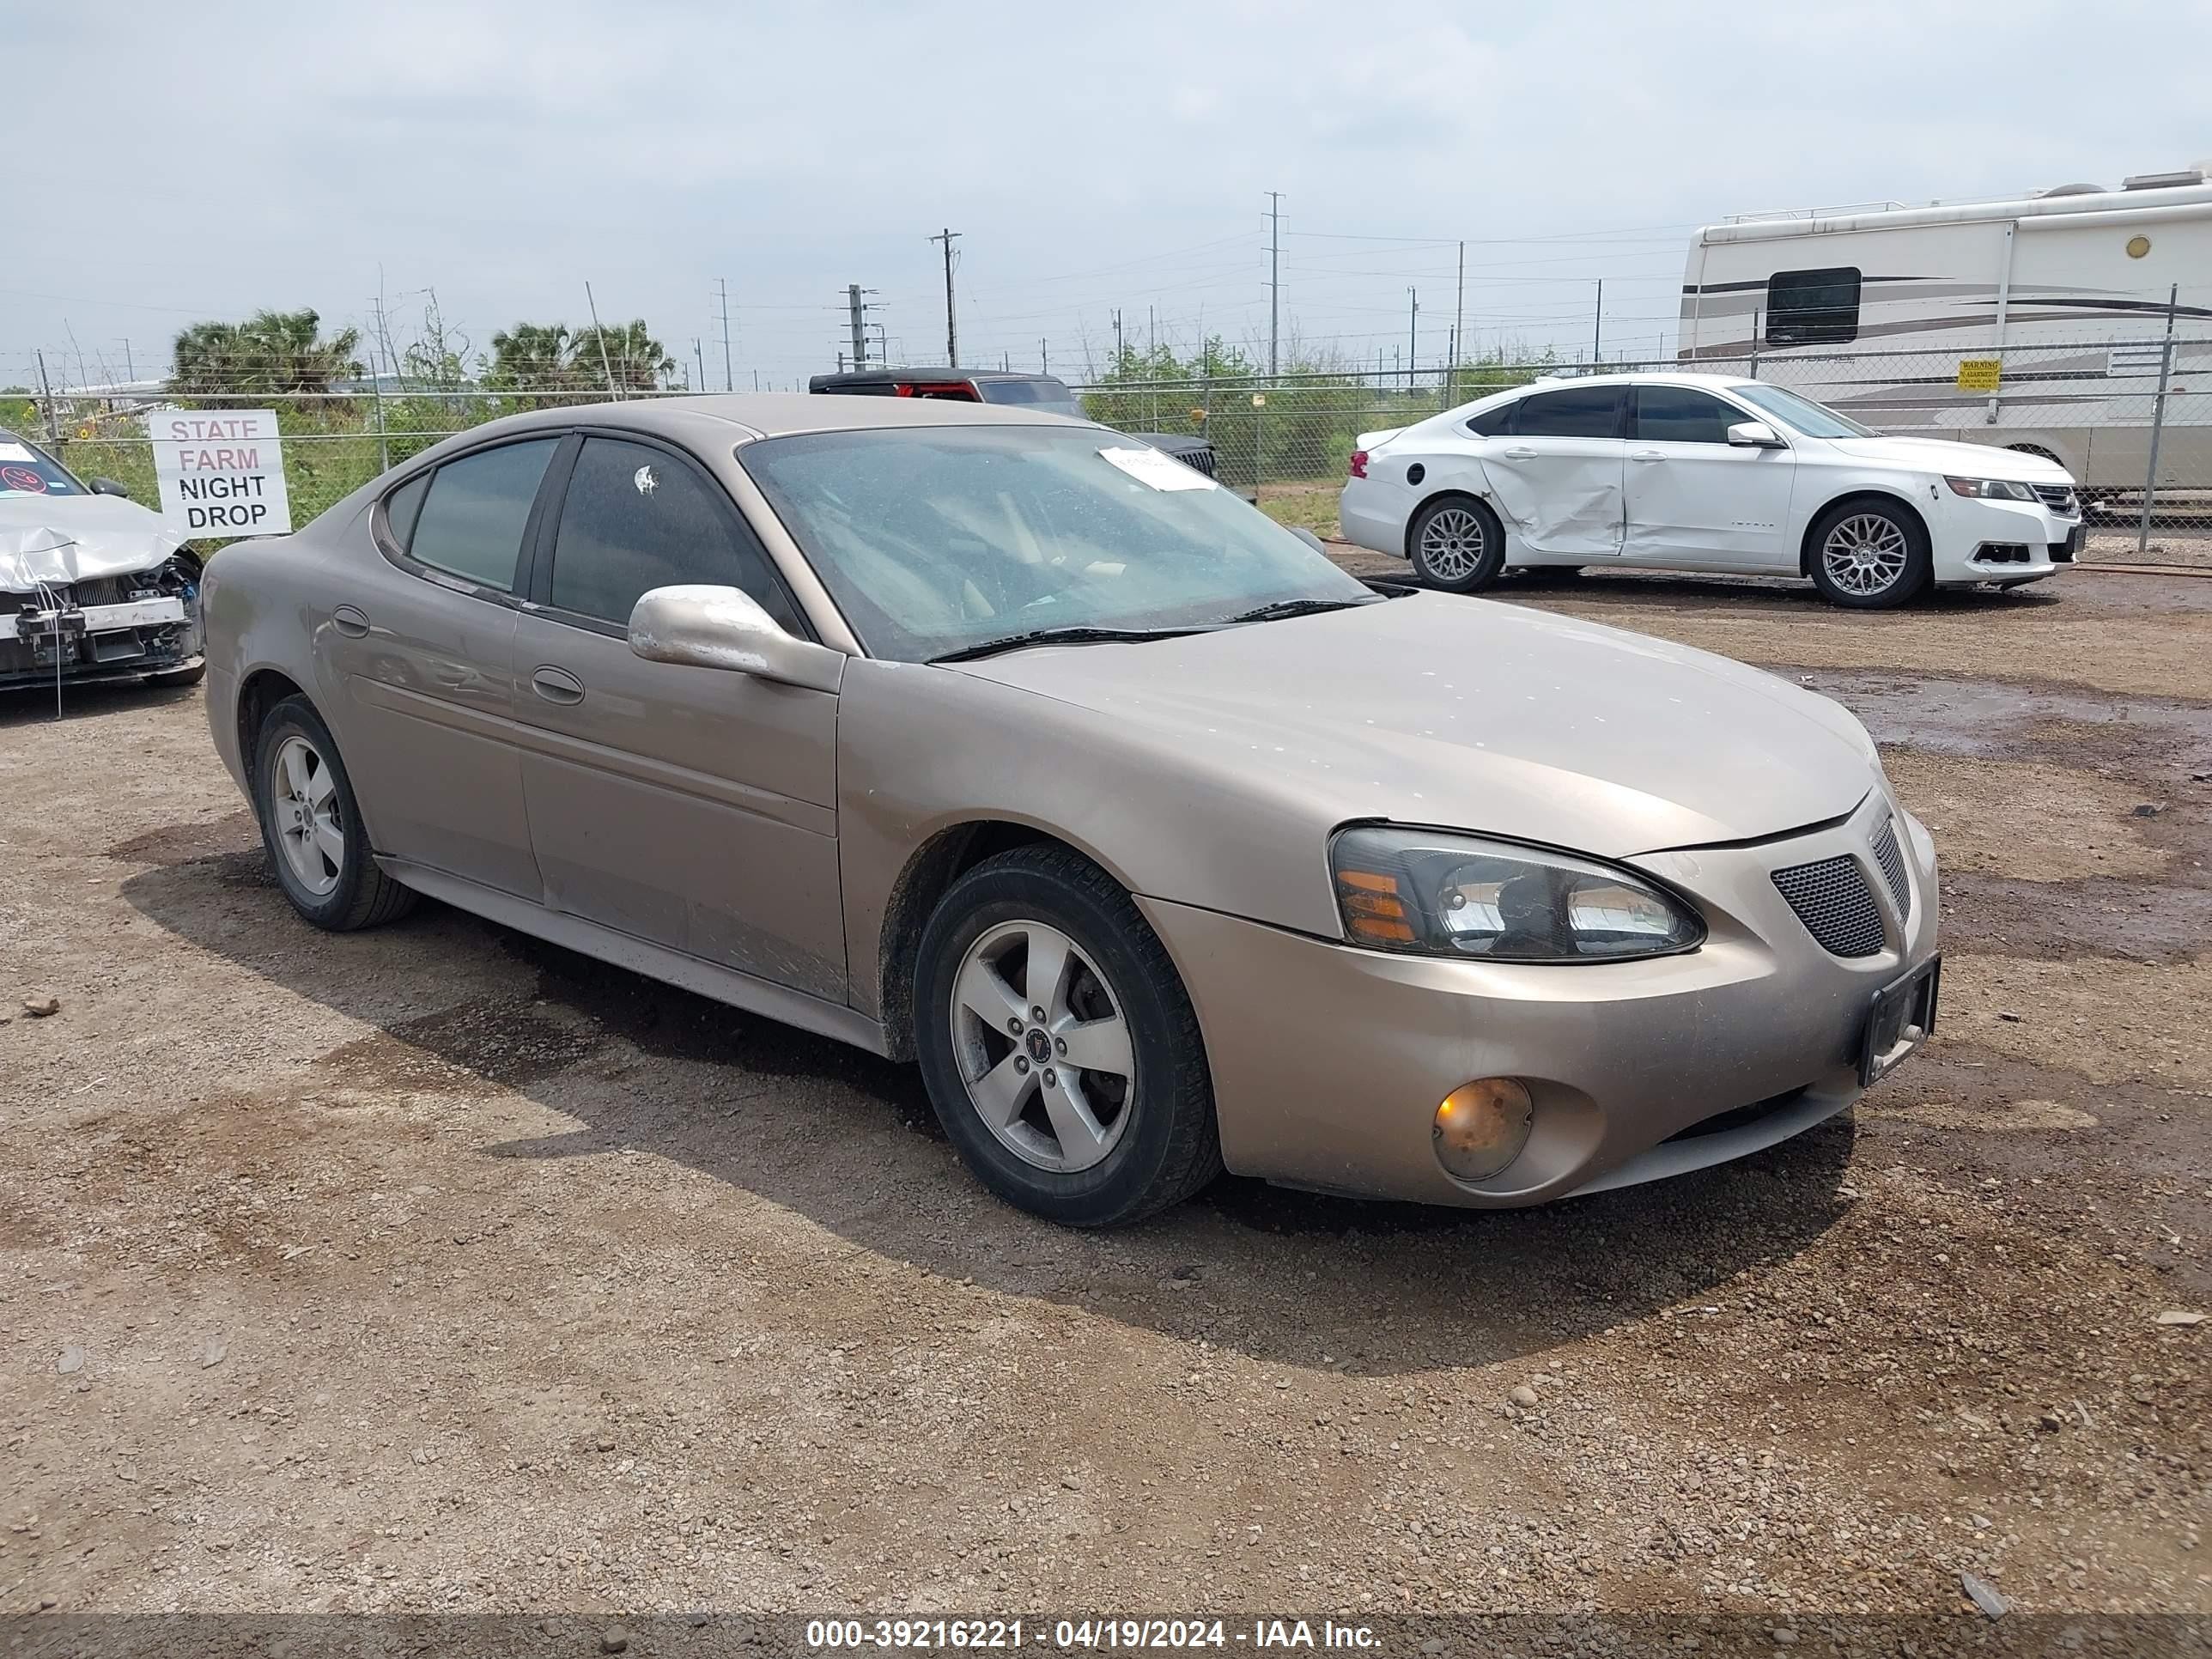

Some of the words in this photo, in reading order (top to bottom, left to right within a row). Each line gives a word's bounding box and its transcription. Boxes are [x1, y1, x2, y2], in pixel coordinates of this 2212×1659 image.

[171, 420, 258, 442] STATE
[179, 448, 259, 471] FARM
[179, 476, 265, 501] NIGHT
[187, 504, 267, 529] DROP
